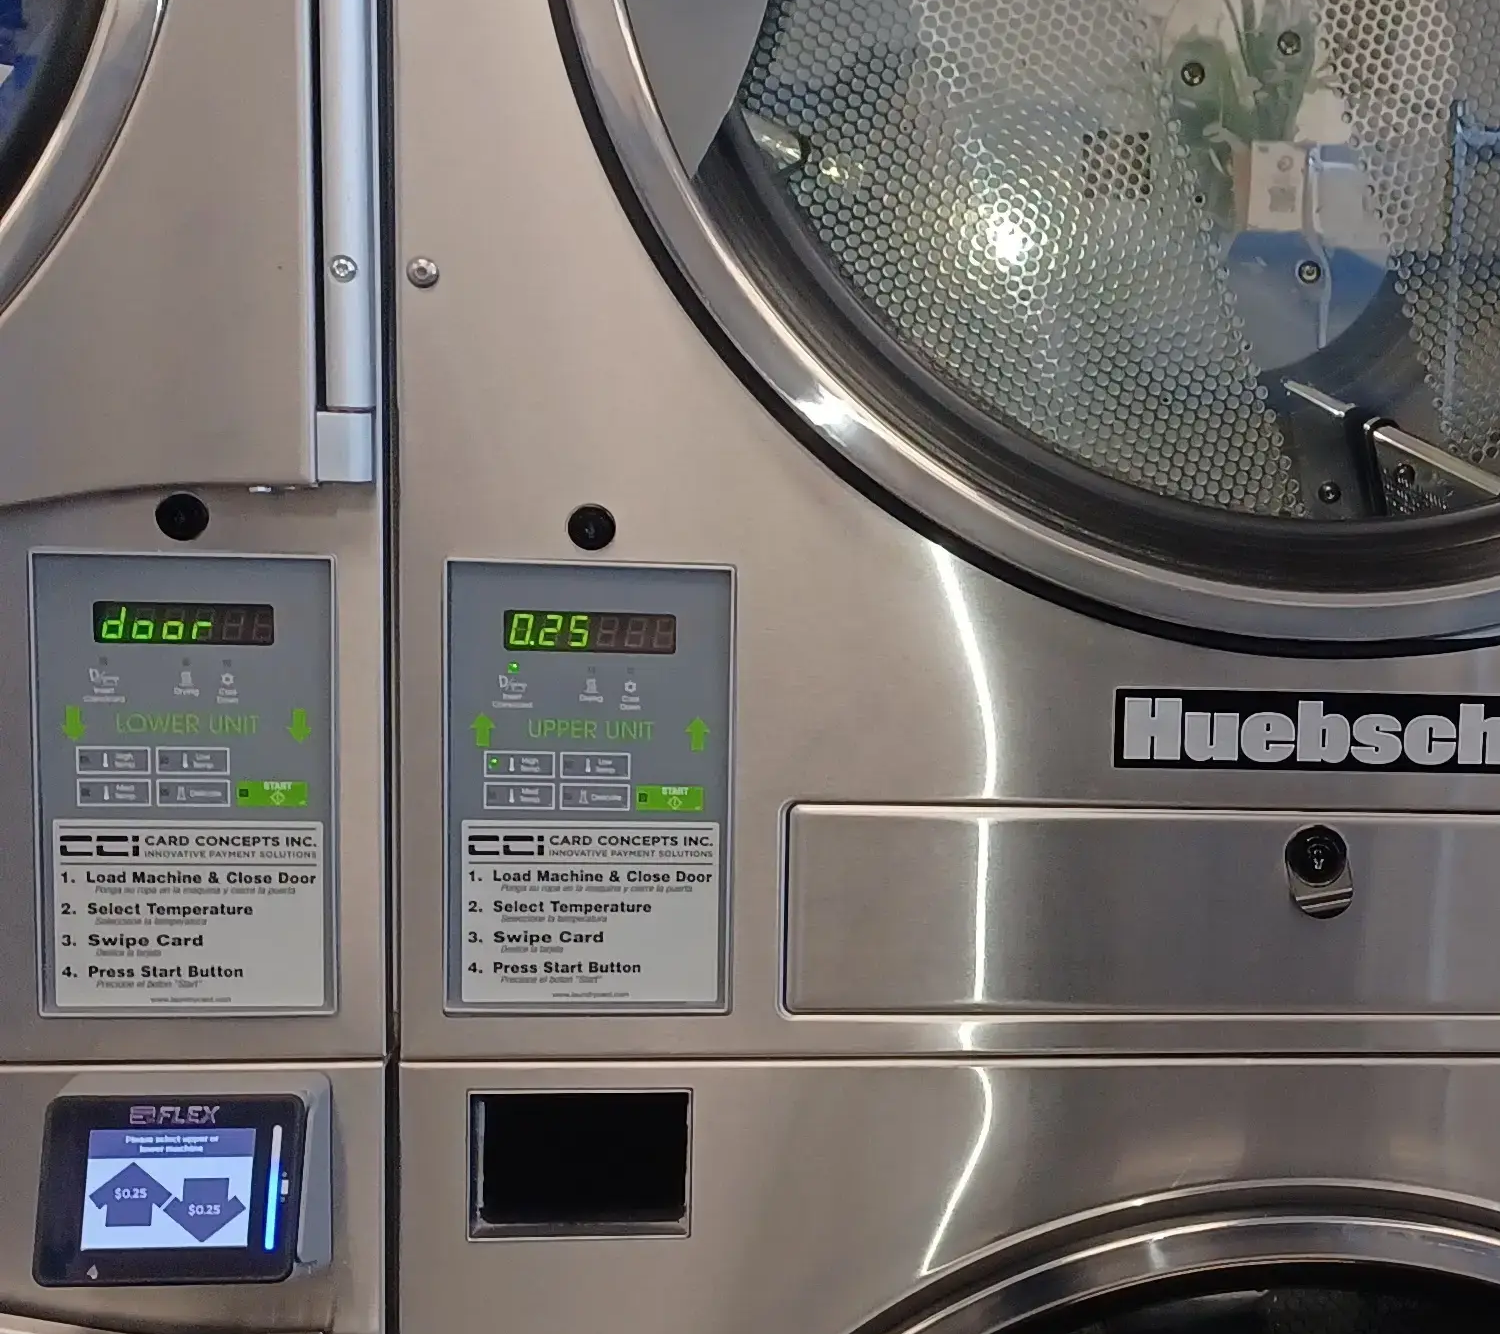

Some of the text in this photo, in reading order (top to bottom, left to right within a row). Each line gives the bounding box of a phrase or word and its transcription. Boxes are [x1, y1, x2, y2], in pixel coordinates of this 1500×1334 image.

[101, 606, 212, 640] door
[509, 614, 589, 647] 0.25
[116, 714, 259, 734] LOWER UNIT
[528, 719, 655, 739] UPPER UNIT
[145, 836, 317, 847] CARD CONCEPTS INC.
[550, 836, 713, 846] CARD CONCEPTS INC.
[260, 851, 317, 859] SOLUTIONS
[659, 850, 713, 858] SOLUTIONS
[61, 871, 317, 884] 1. Load Machine & Close Door
[469, 870, 713, 883] 1. Load Machine & Close Door
[61, 903, 253, 917] 2. Select Temperature
[468, 901, 651, 914] 2. Select Temperature
[62, 934, 204, 949] 3. Swipe Card
[468, 931, 604, 945] 3. Swipe Card
[62, 966, 243, 978] 4. Press Start Button
[468, 962, 641, 973] 4. Press Start Button
[115, 1187, 147, 1200] $0.25
[188, 1204, 220, 1216] $0.25
